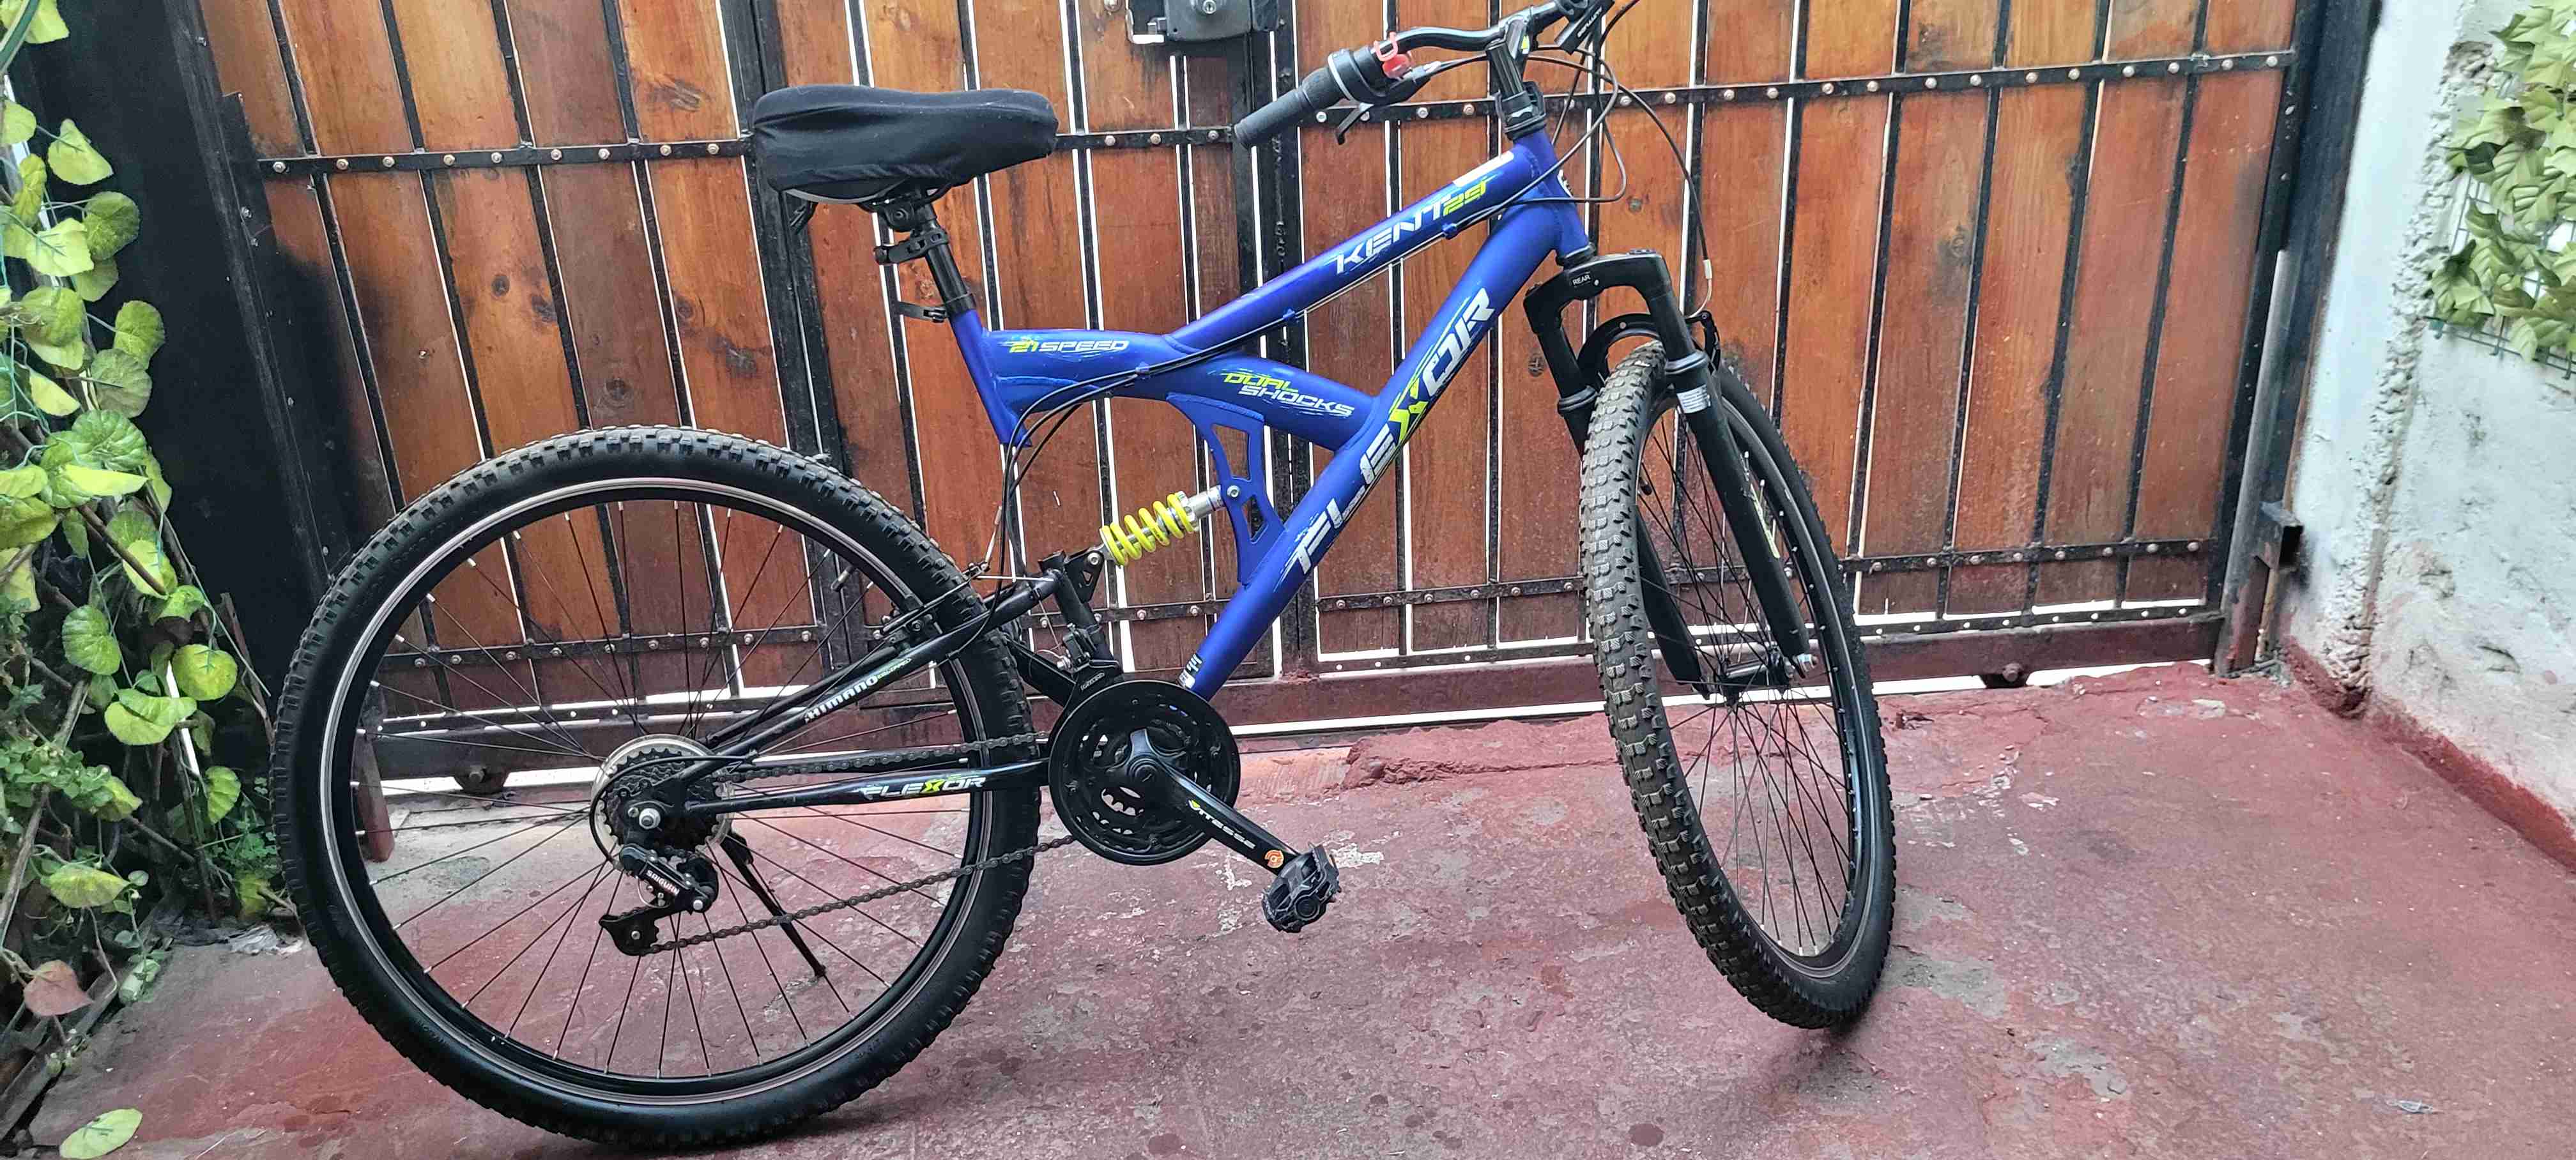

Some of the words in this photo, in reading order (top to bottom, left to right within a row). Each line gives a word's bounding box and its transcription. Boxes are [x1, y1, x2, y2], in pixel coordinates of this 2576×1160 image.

[1337, 194, 1452, 275] KENT
[1572, 274, 1591, 286] REAR
[1009, 339, 1039, 353] 21
[1038, 340, 1130, 353] SPEED
[1224, 372, 1299, 393] DUAL
[1238, 385, 1355, 417] SHOCKS
[1296, 287, 1495, 574] FLEXOR
[859, 776, 986, 800] FLEXOR
